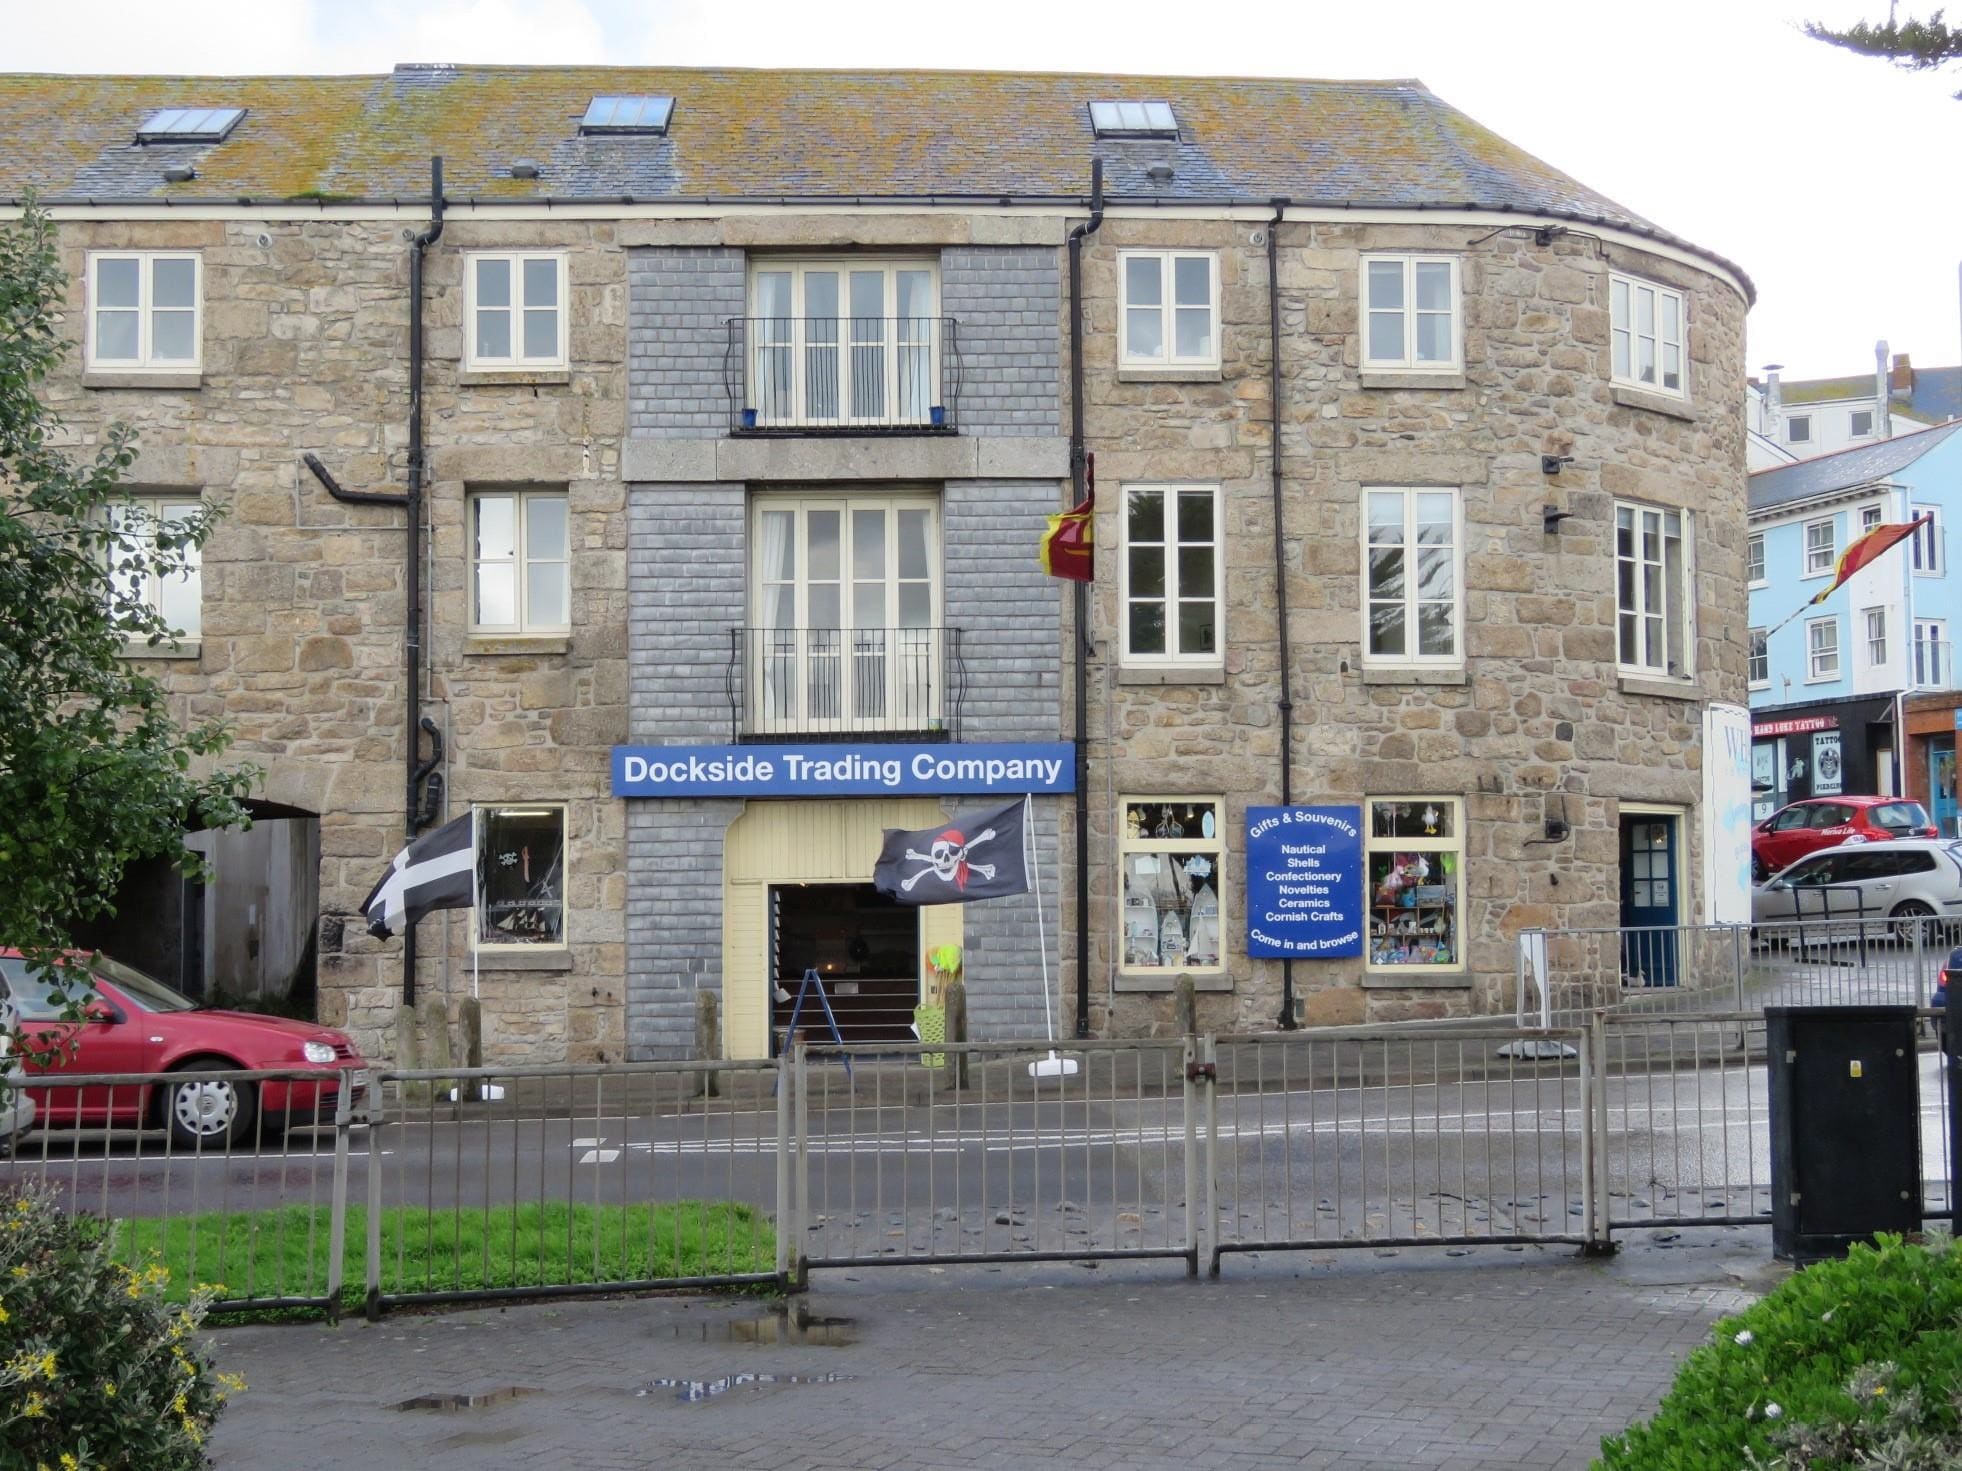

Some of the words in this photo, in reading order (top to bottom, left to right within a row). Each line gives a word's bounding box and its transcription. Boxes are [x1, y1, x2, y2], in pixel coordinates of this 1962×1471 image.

[1794, 718, 1825, 731] TATTOO
[624, 755, 774, 782] Dockside
[782, 754, 901, 786] Trading
[911, 753, 1063, 785] Company
[1815, 783, 1840, 791] PIERCIN
[1250, 817, 1279, 838] Gifts
[1282, 812, 1292, 823] &
[1295, 811, 1357, 837] Souvenirs
[1281, 844, 1326, 854] Nautical
[1287, 858, 1320, 867] Shells
[1266, 871, 1342, 883] Confectionery
[1279, 885, 1329, 894] Novelties
[1279, 898, 1330, 908] Ceramics
[1265, 912, 1308, 921] Cornish
[1310, 911, 1344, 921] Crafts
[1251, 929, 1282, 947] Come
[1284, 939, 1294, 949] in
[1296, 941, 1317, 950] and
[1319, 931, 1359, 949] browse
